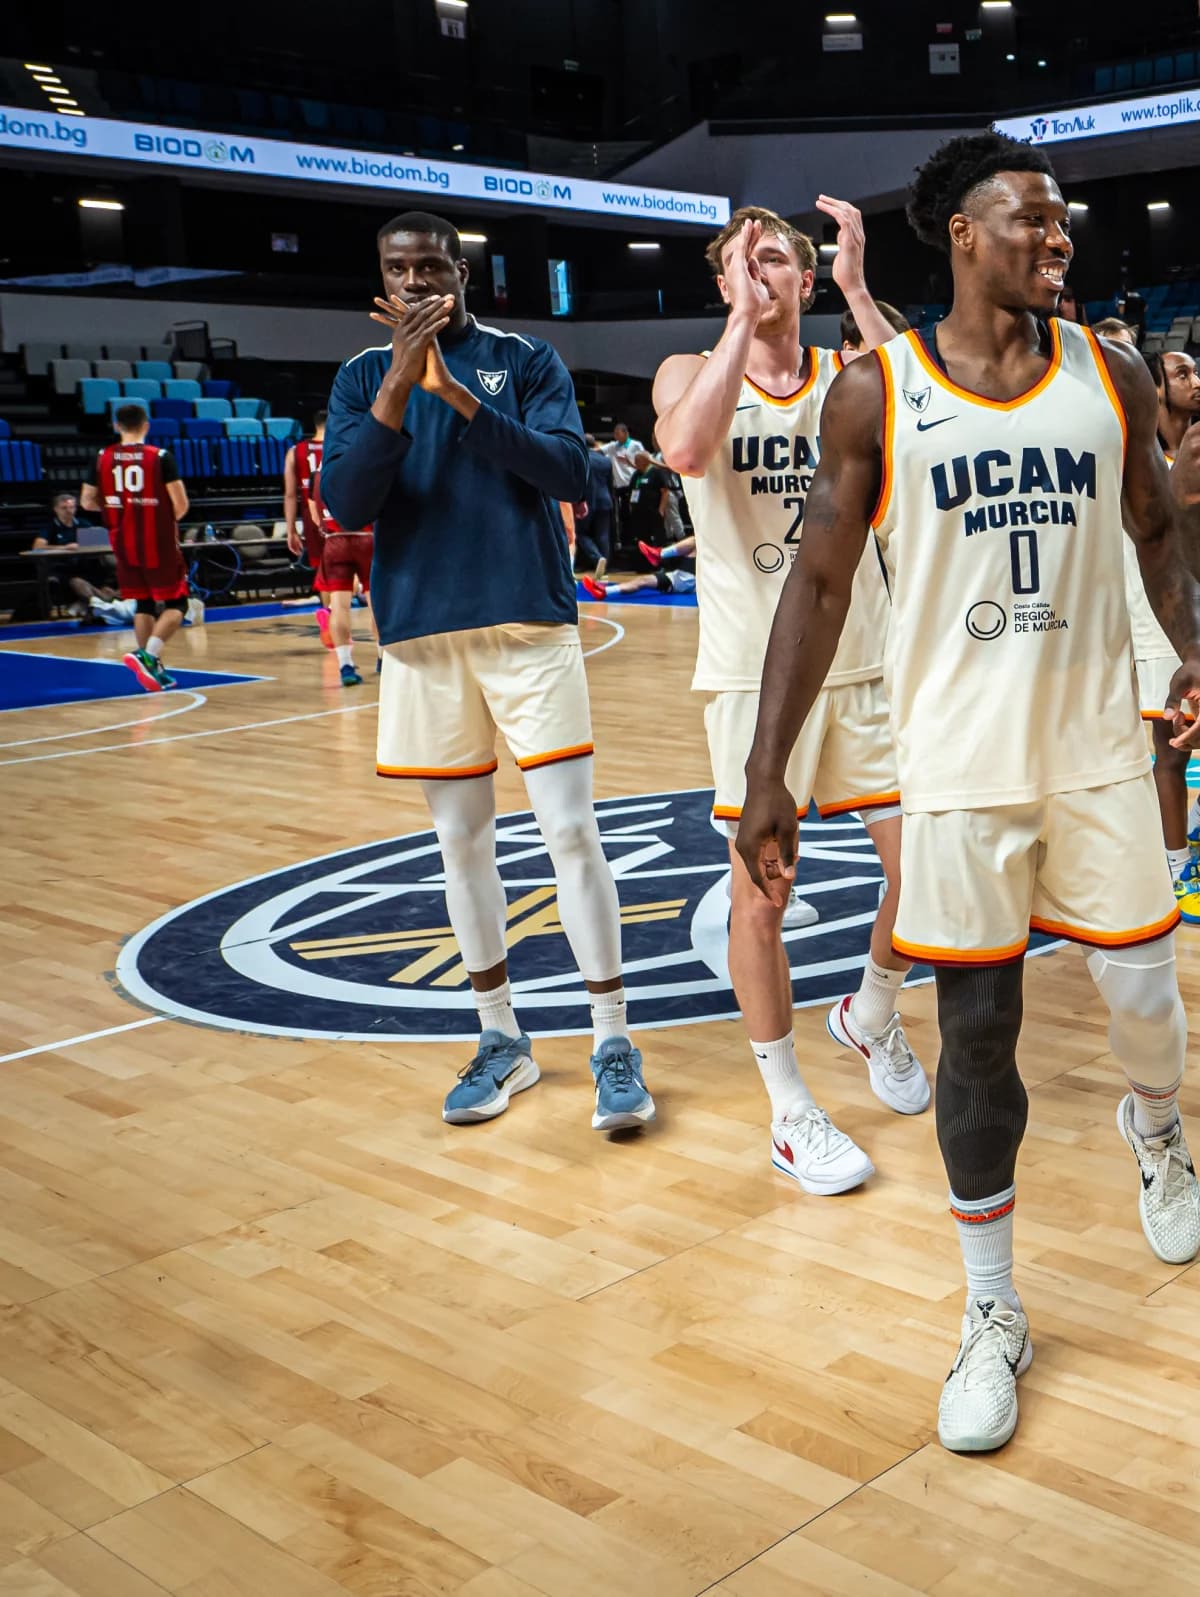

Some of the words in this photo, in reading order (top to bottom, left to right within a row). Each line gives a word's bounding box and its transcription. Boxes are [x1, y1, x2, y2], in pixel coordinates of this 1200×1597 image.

[296, 154, 450, 188] www.biodom.bg
[602, 191, 717, 219] www.biodom.bg
[733, 435, 823, 472] UCA
[112, 465, 144, 492] 10
[751, 475, 813, 495] MURC
[931, 447, 1096, 511] UCAM
[964, 500, 1077, 537] MURCIA
[1009, 530, 1041, 595] 0
[1014, 609, 1056, 622] REGIÓN
[1014, 623, 1029, 632] DE
[1032, 619, 1068, 632] MURCIA
